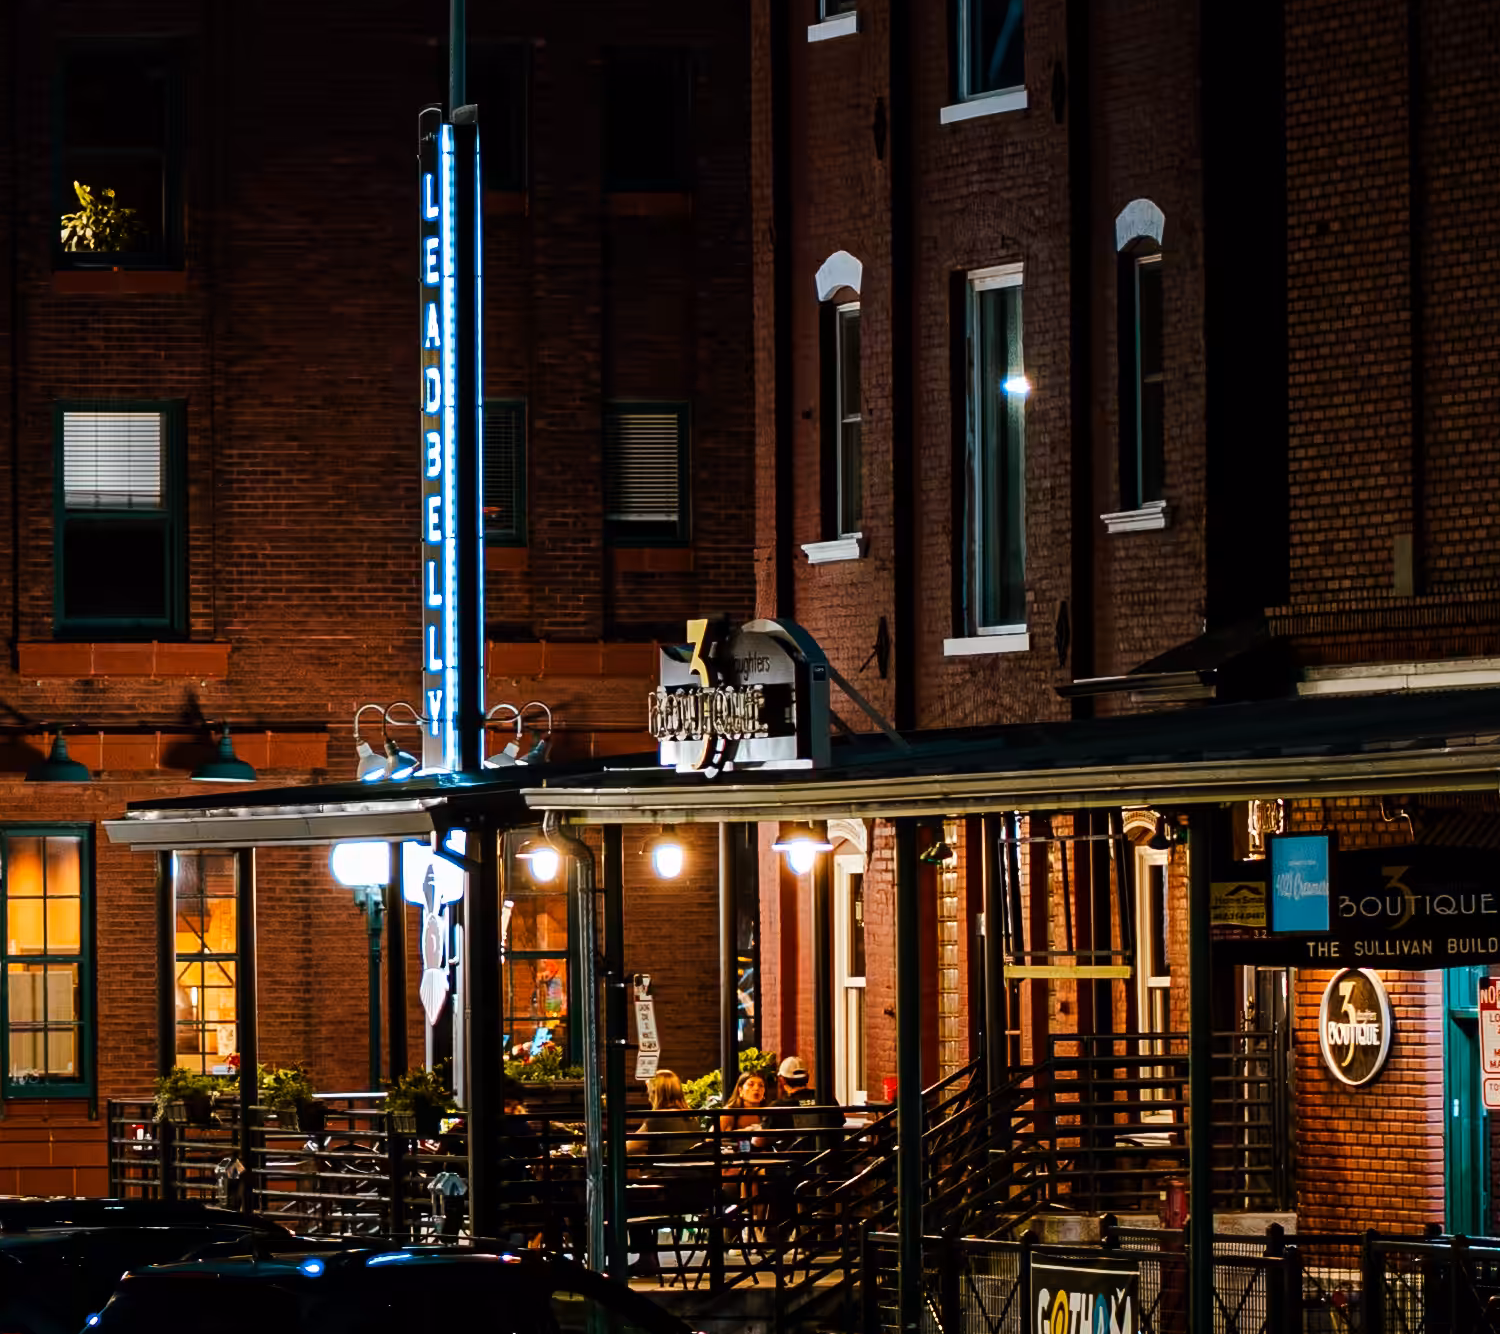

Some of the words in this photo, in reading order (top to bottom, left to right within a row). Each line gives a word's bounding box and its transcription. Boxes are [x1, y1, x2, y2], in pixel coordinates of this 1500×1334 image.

[423, 173, 443, 737] LEADBELLY
[1339, 893, 1498, 918] BOUTIQUE
[1306, 941, 1340, 958] THE
[1354, 939, 1433, 957] SULLIVAN
[1480, 985, 1496, 1004] NO
[1328, 1021, 1380, 1046] BOUTIQUE
